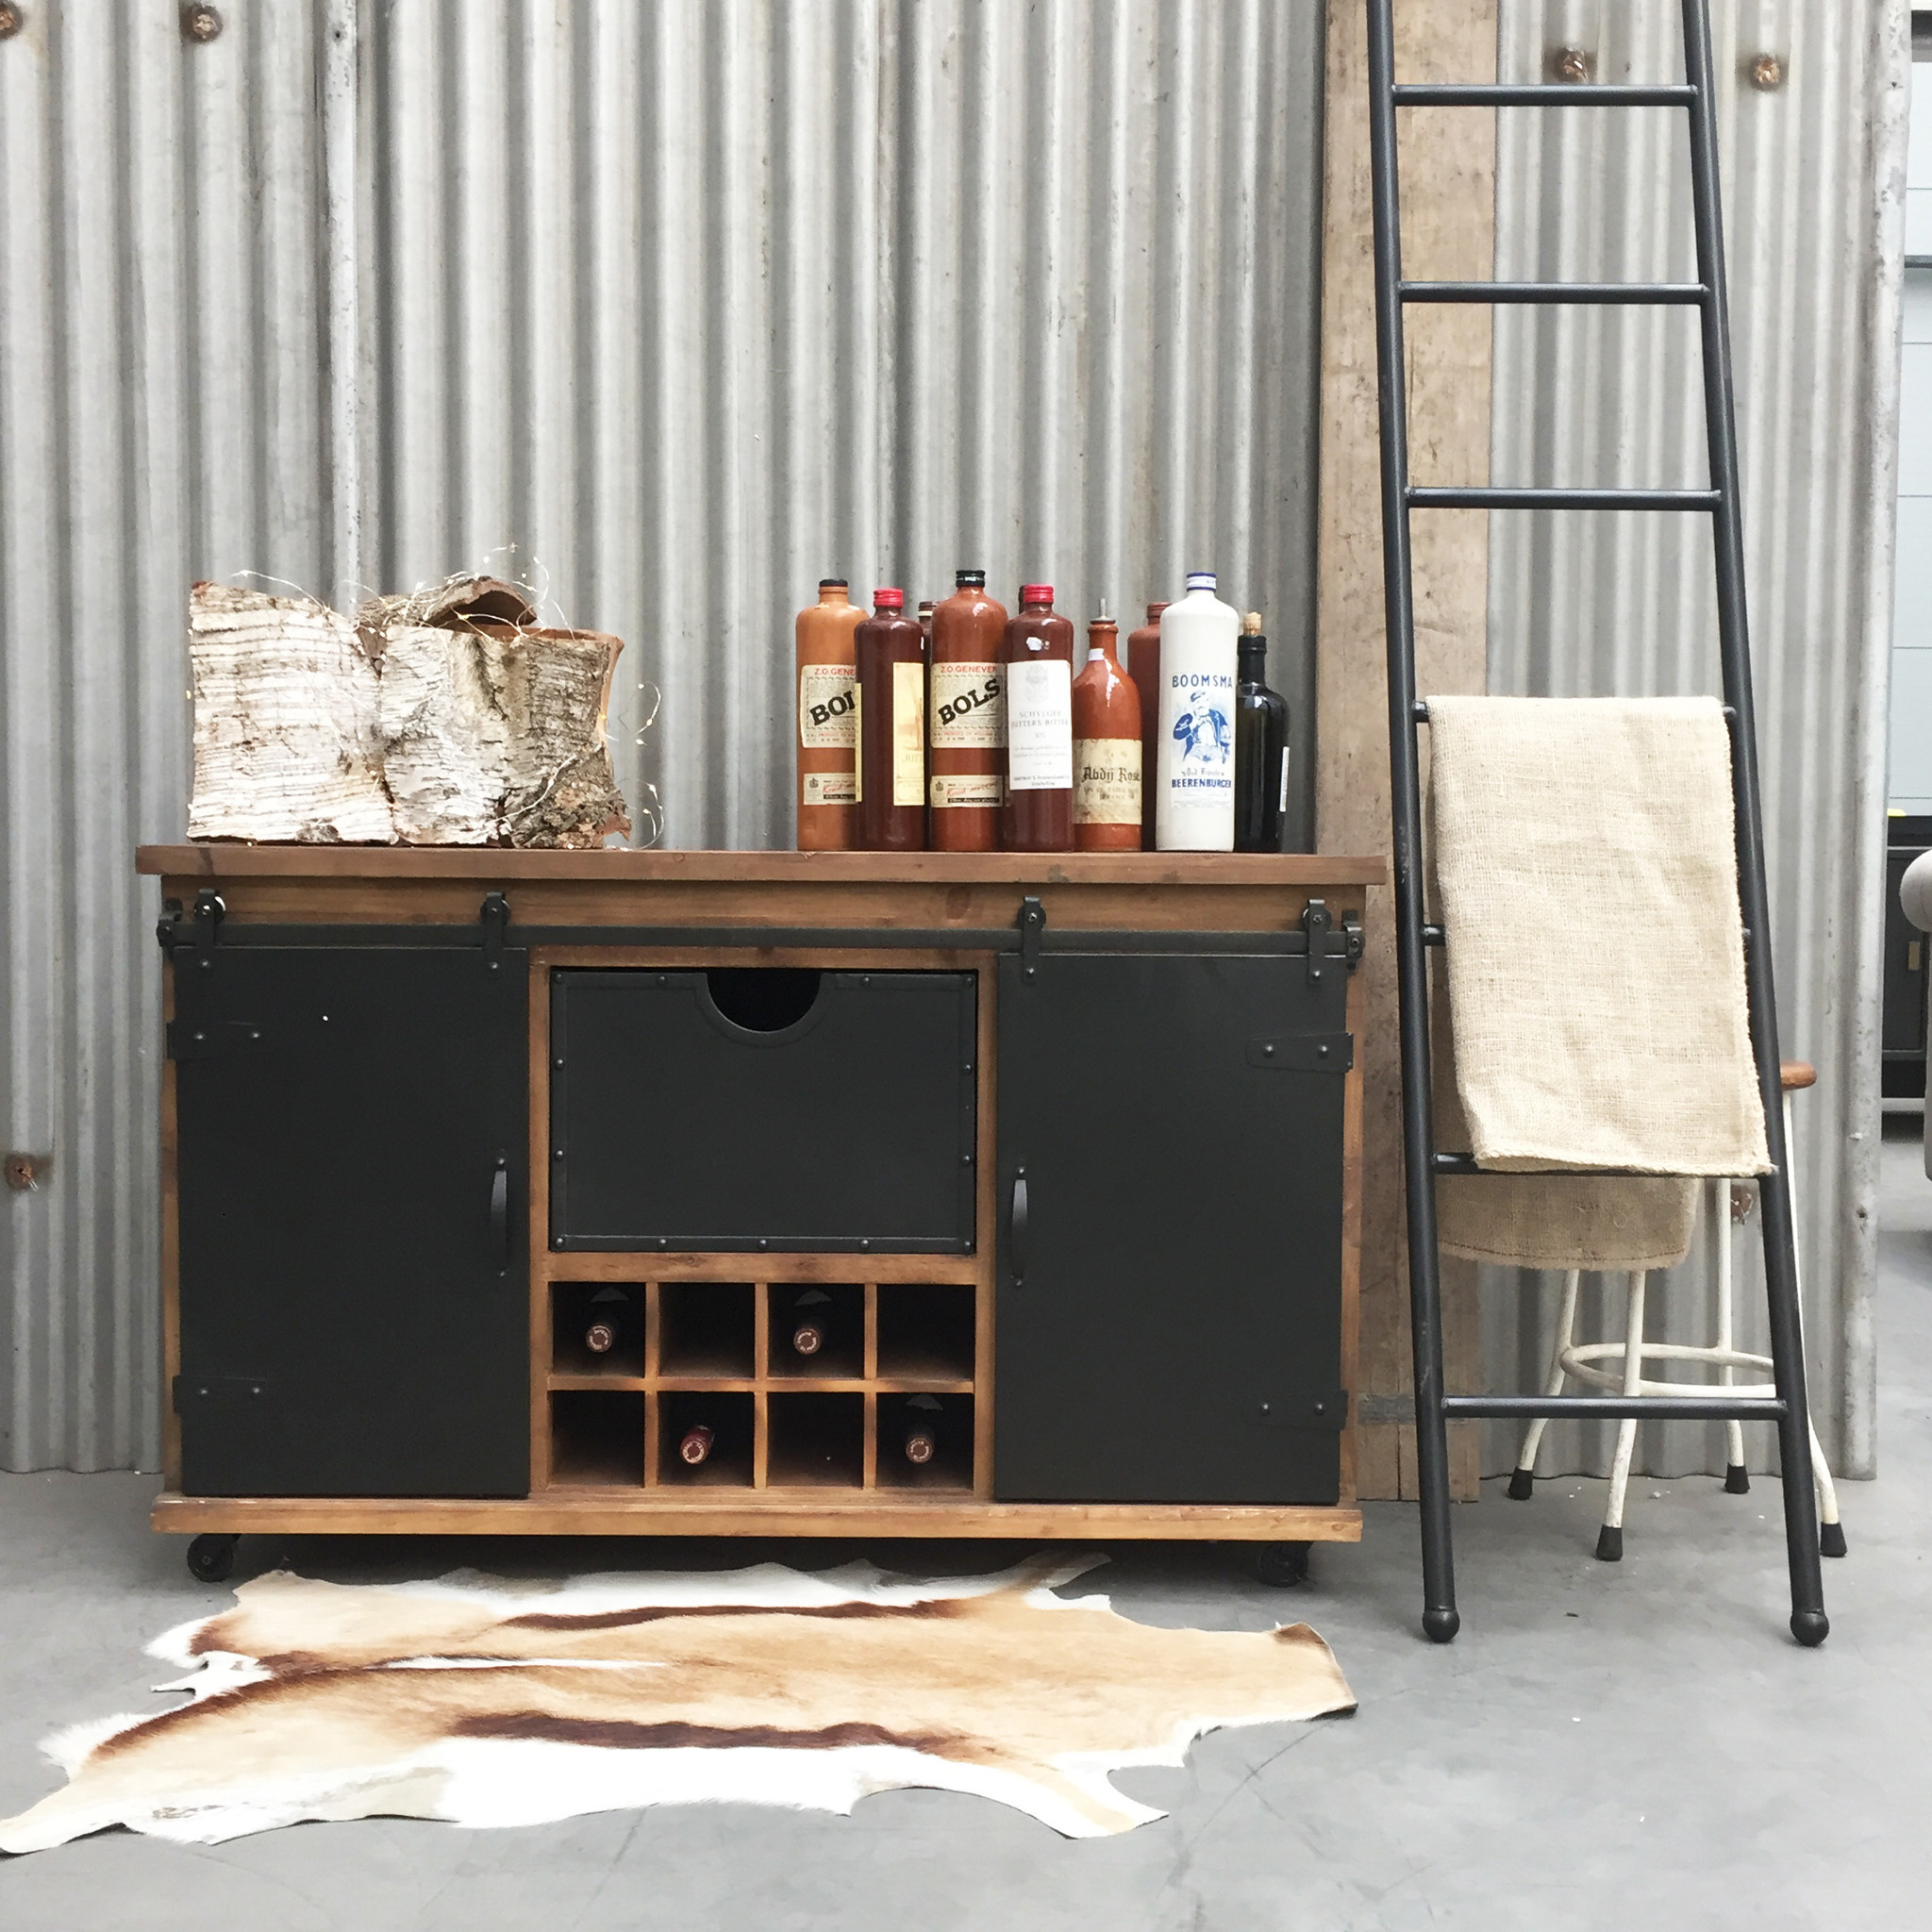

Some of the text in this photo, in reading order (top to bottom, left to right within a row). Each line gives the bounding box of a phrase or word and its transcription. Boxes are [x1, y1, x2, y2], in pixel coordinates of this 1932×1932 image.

[1172, 674, 1232, 689] BOOMSMA
[938, 677, 1001, 726] BOLS
[1081, 765, 1115, 784] Abdij
[1171, 778, 1232, 789] BEERENBURGER
